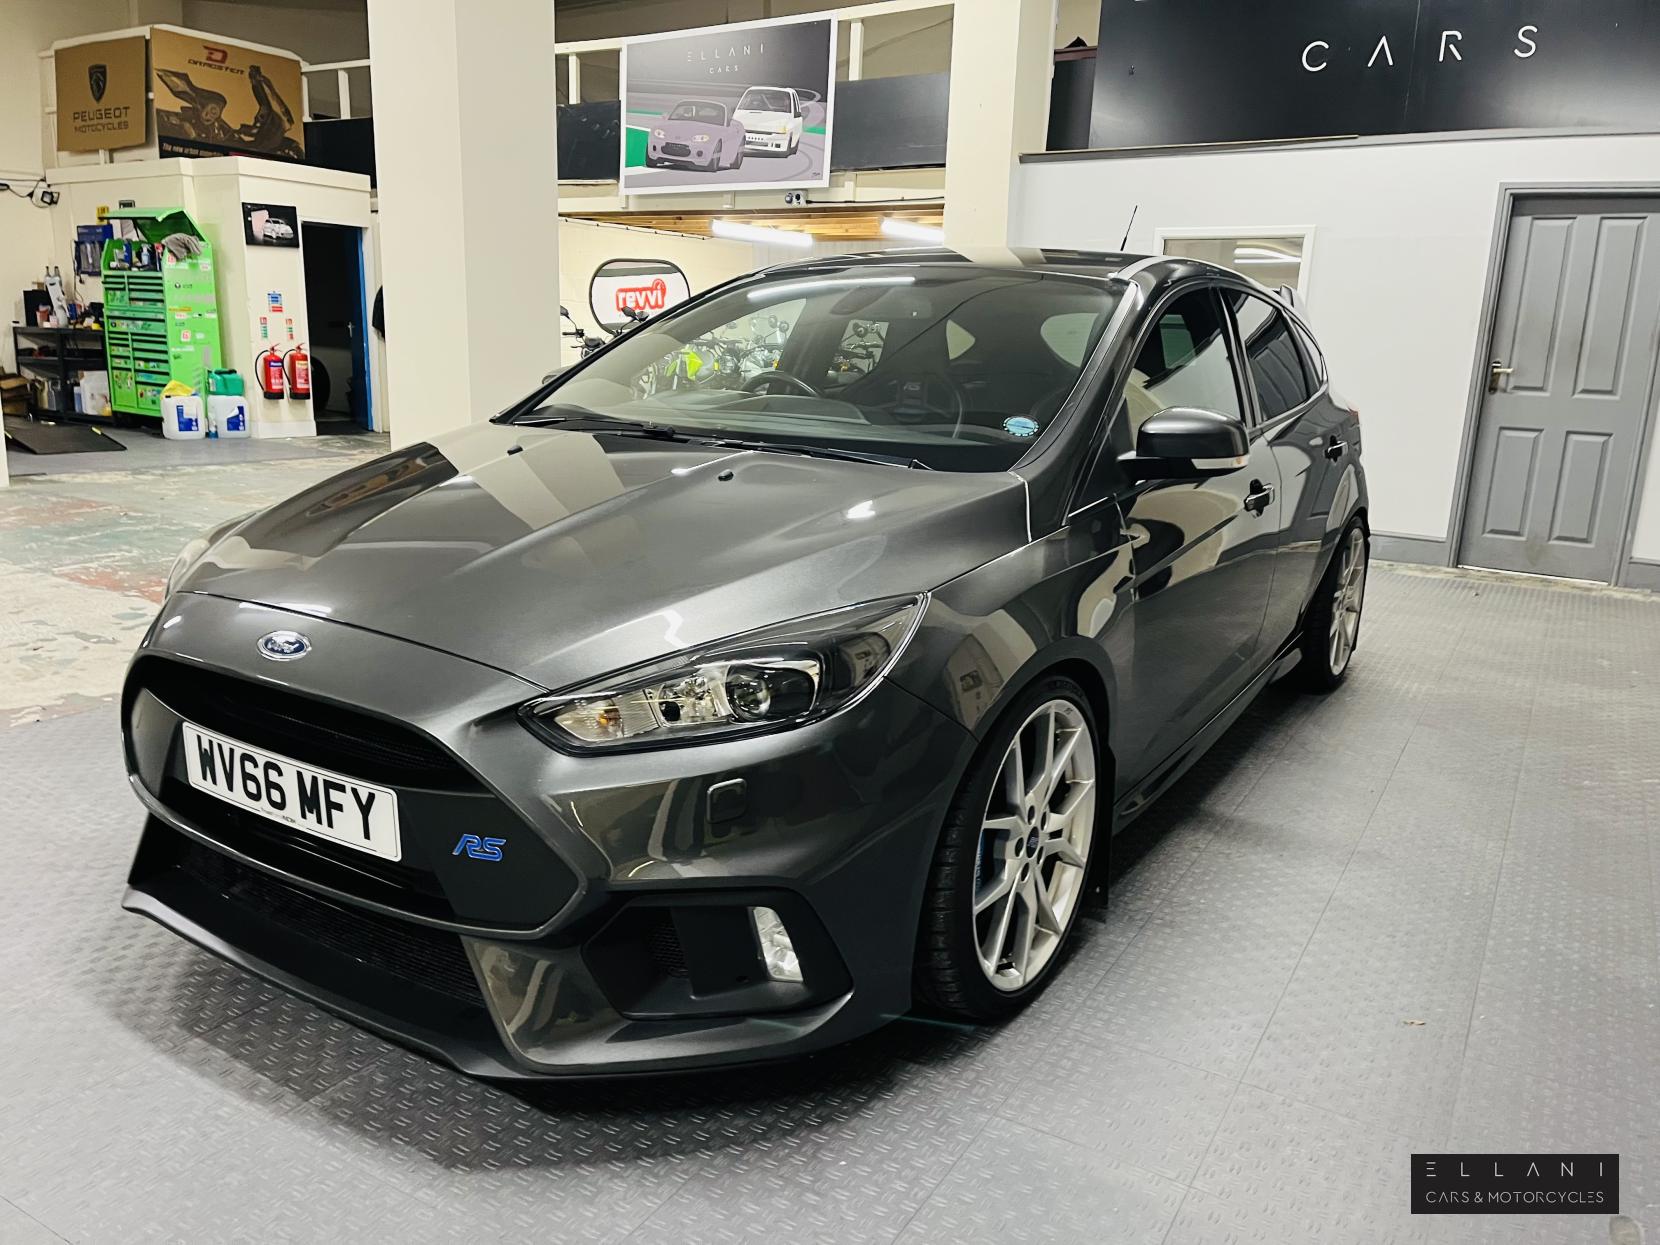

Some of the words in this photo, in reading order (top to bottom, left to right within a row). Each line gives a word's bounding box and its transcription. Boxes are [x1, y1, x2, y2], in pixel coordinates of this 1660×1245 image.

[687, 43, 763, 62] ELLANI
[1301, 24, 1540, 73] CARS
[709, 65, 739, 74] CARS
[72, 106, 131, 123] PEUGEOT
[617, 284, 663, 308] revvi
[196, 734, 287, 811] WV66
[296, 770, 376, 841] MFY
[452, 833, 507, 862] RS
